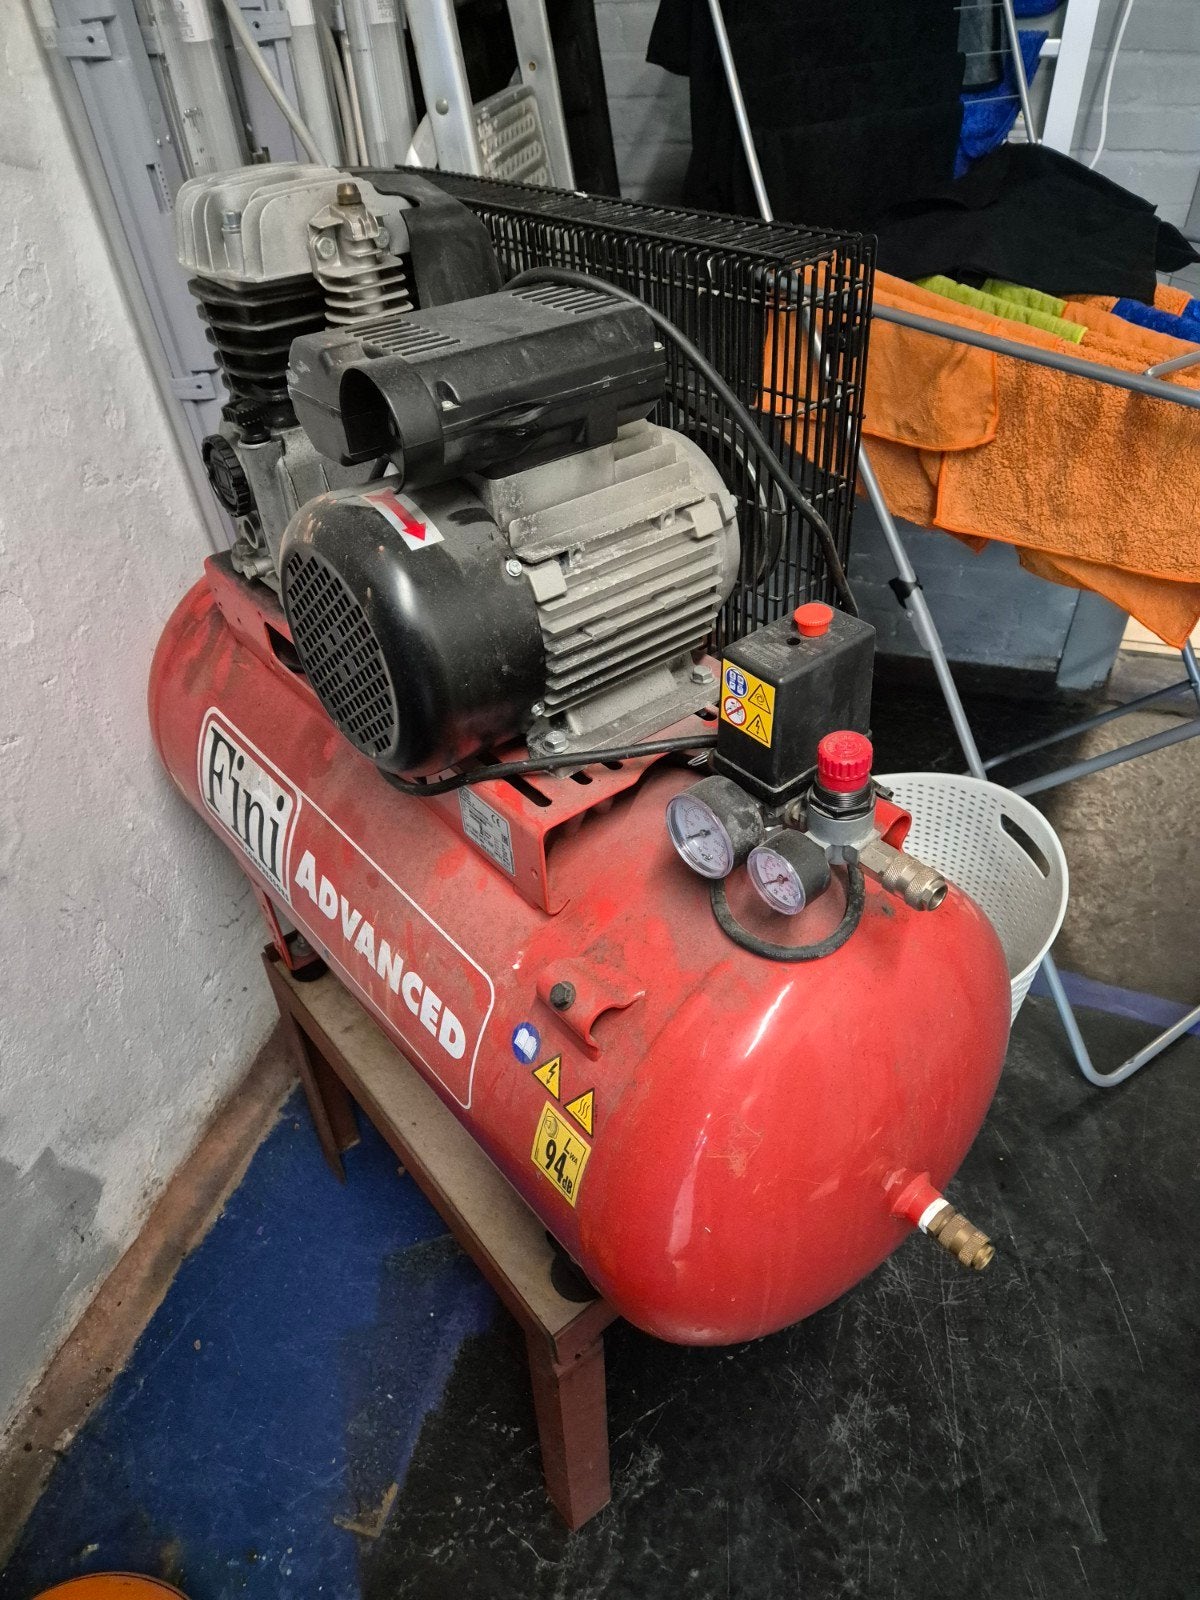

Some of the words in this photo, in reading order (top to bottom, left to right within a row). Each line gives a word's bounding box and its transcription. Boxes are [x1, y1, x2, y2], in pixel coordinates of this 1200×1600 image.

[207, 727, 286, 882] Fini
[294, 850, 466, 1060] ADVANCED
[545, 1139, 567, 1183] 94
[562, 1176, 573, 1194] dB
